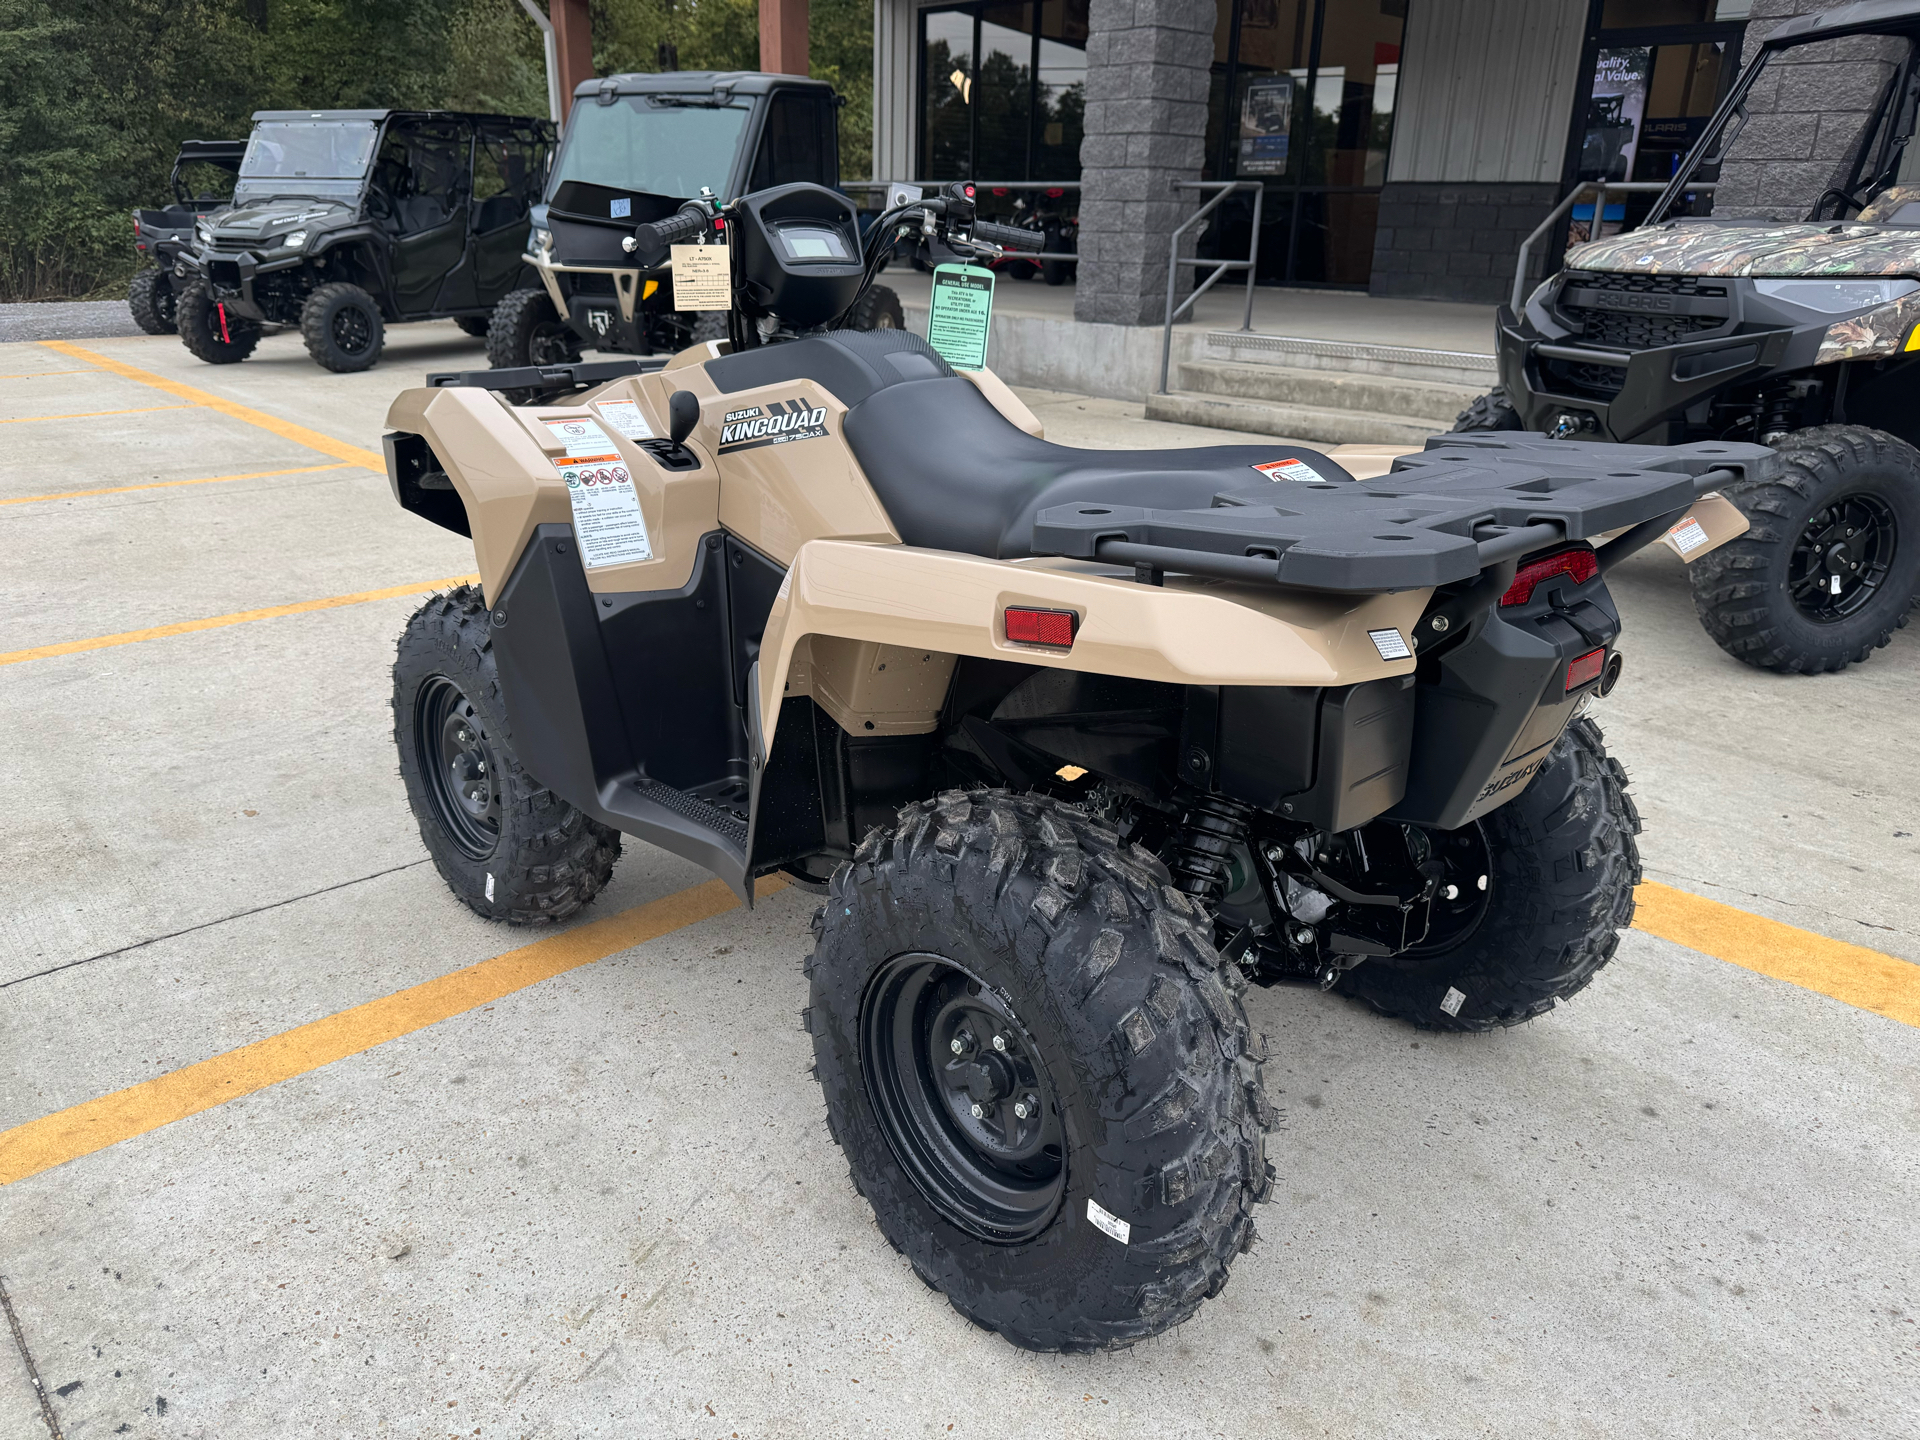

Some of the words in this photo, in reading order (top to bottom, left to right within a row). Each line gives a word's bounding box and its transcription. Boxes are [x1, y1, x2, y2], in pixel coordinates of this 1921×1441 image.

[1607, 70, 1640, 81] Value.
[1596, 293, 1671, 312] POLARIS
[726, 408, 759, 422] SUZUKI
[720, 407, 827, 444] KINGQUAD
[1476, 756, 1546, 802] SUZUKI
